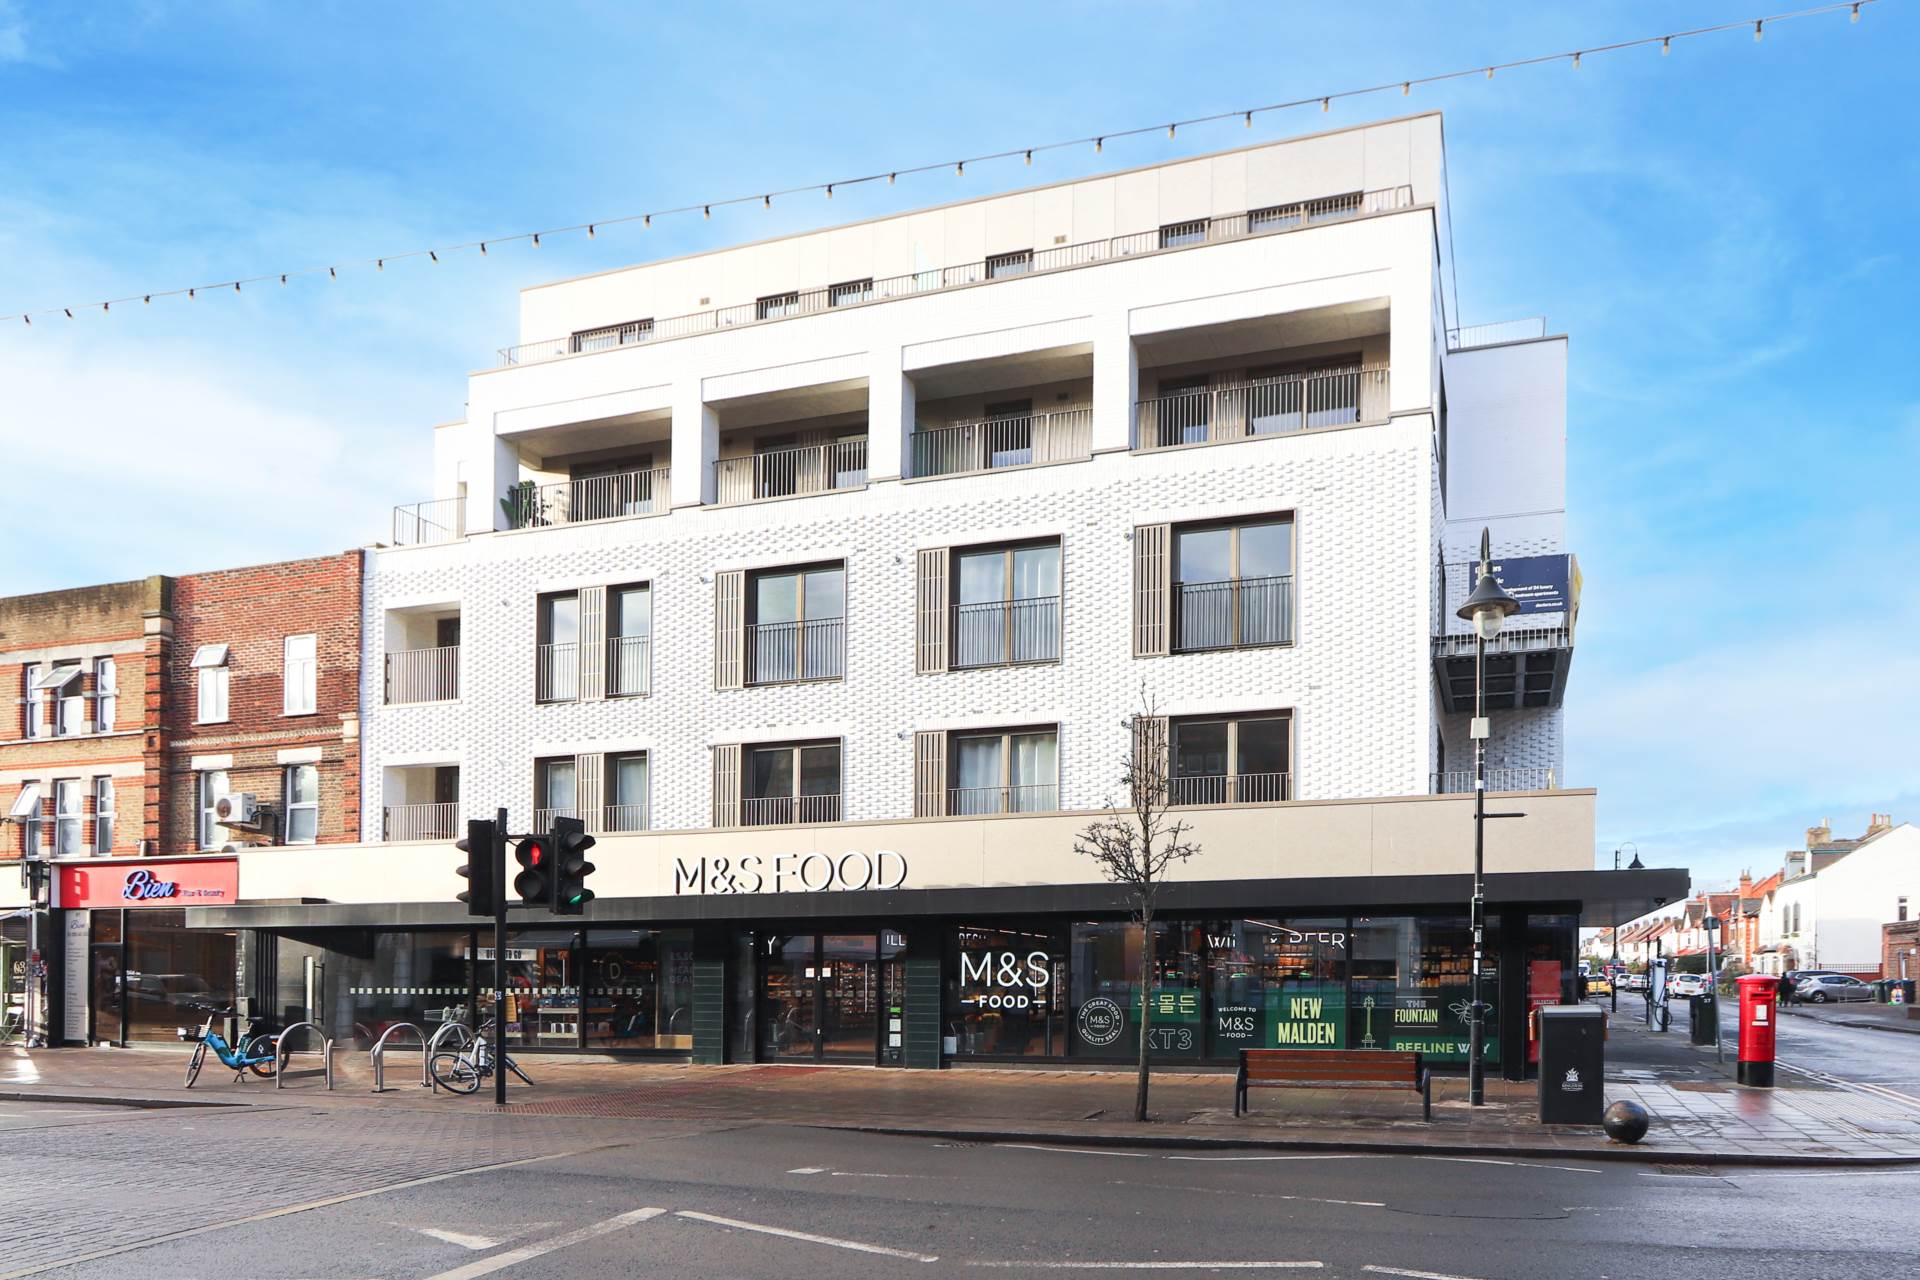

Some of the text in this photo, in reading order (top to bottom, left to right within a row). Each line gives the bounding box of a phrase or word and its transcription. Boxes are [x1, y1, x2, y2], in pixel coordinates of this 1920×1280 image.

[673, 850, 907, 895] M&S FOOD
[123, 870, 176, 900] Bien
[961, 951, 1050, 988] M&S
[979, 995, 1029, 1009] FOOD
[1290, 997, 1323, 1019] NEW
[1406, 1000, 1427, 1008] THE
[1080, 1001, 1120, 1020] THE GREAT FOOD
[1394, 1008, 1439, 1023] FOUNTAIN
[1090, 1015, 1110, 1024] M&S
[1219, 1016, 1254, 1031] M&S
[1081, 1028, 1119, 1042] QUALITY SEAL
[1278, 1022, 1336, 1044] MALDEN
[1395, 1042, 1491, 1054] BEELINE WY
